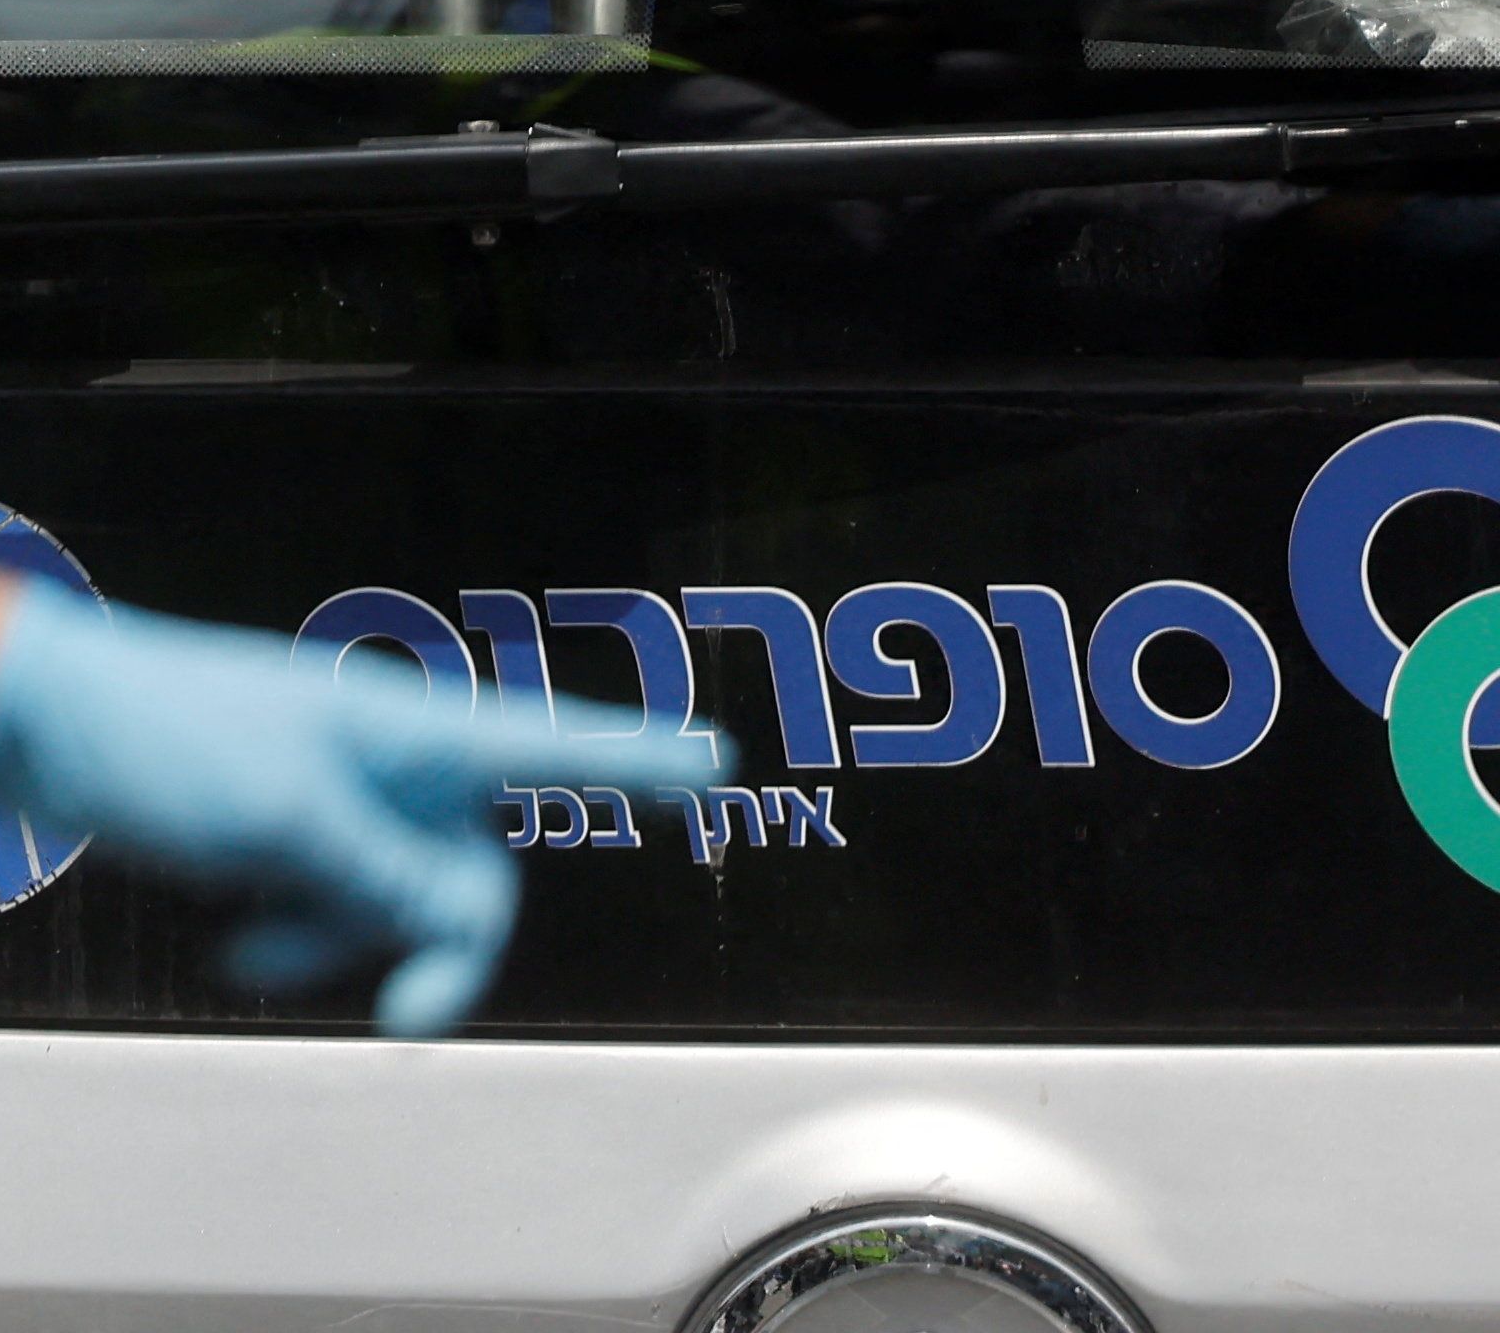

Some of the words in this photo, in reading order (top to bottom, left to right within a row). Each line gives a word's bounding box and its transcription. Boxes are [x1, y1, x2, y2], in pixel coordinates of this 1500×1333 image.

[290, 580, 1281, 768] סופרבוס
[493, 778, 642, 849] בכל
[654, 785, 848, 864] איתך
